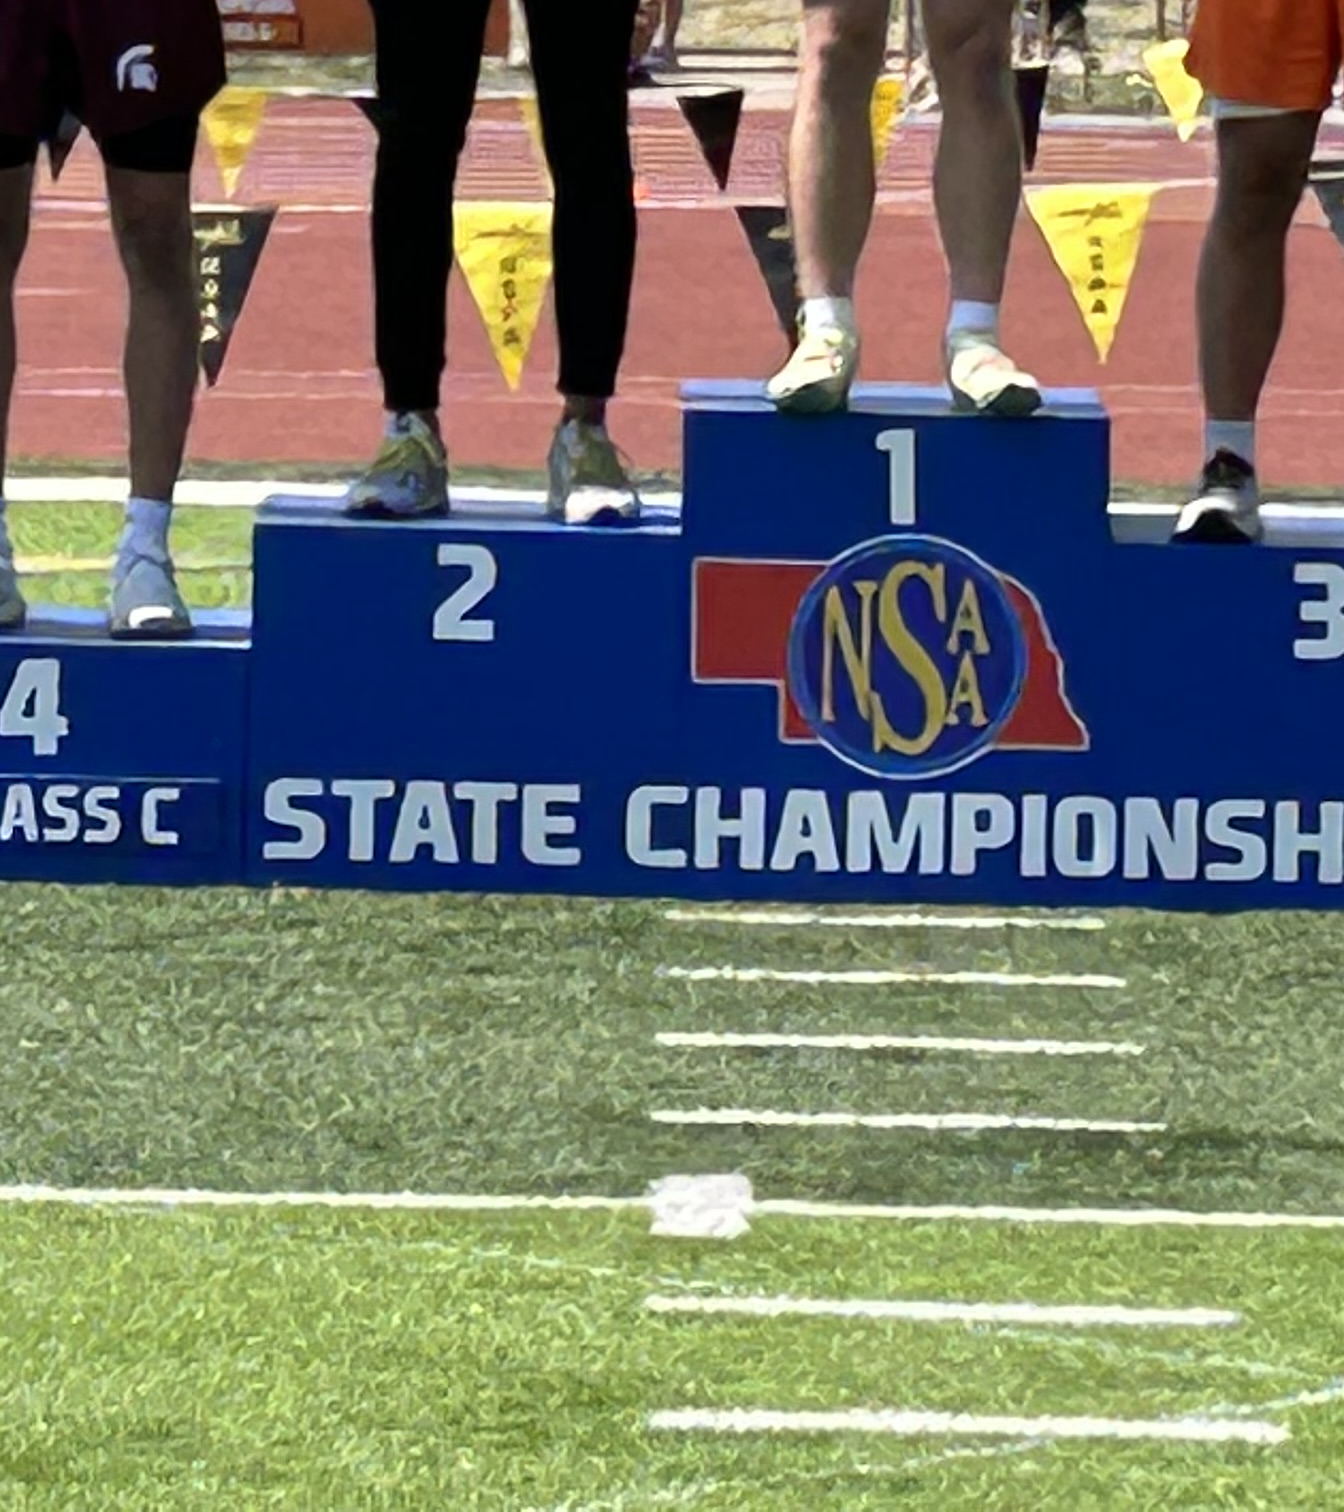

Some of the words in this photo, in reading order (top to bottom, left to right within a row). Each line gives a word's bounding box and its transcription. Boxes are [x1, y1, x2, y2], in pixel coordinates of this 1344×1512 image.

[875, 428, 916, 525] 1
[432, 543, 497, 641] 2
[141, 787, 181, 845] C
[263, 777, 581, 866] STATE
